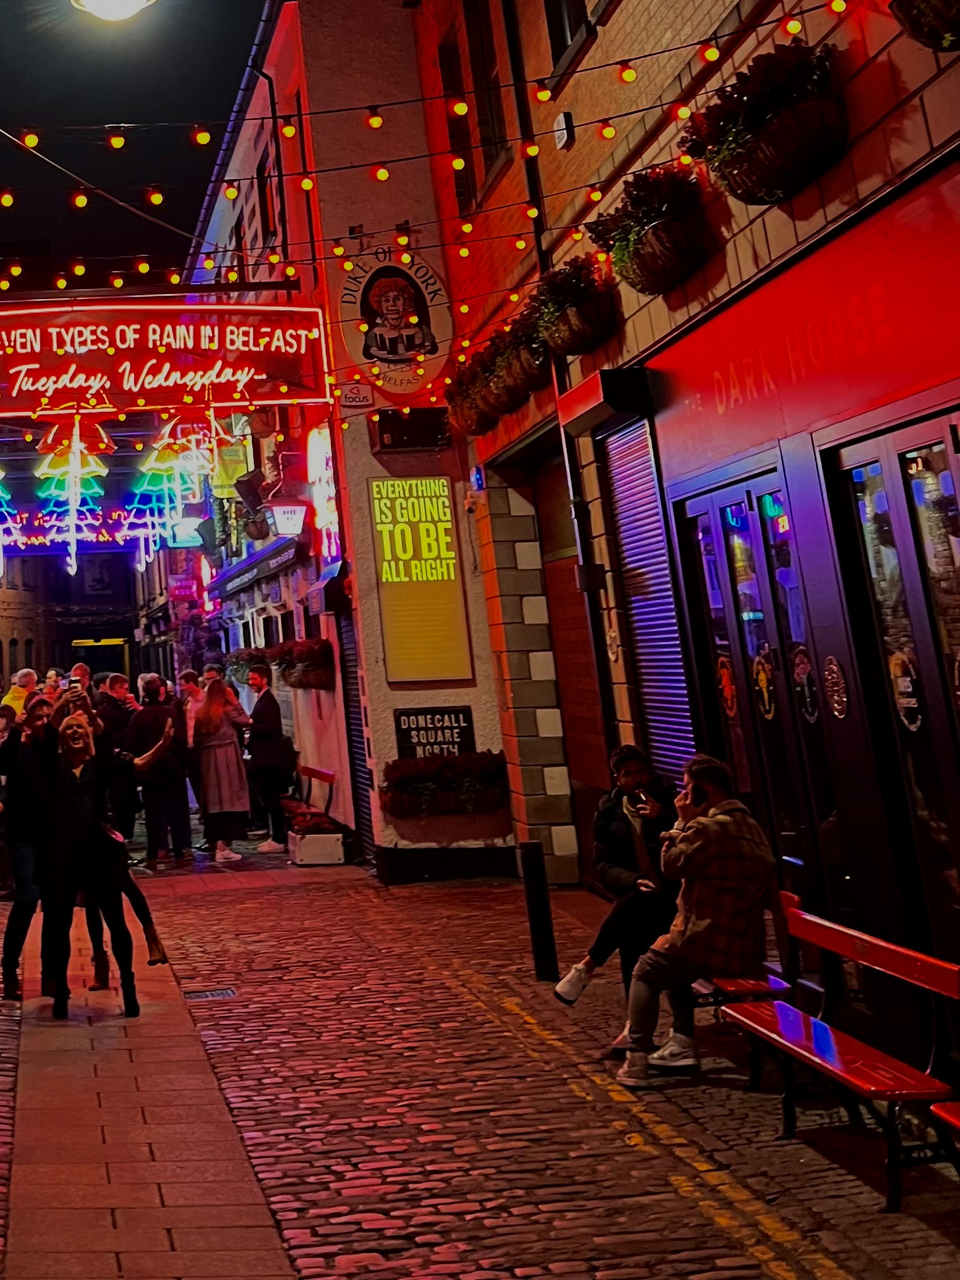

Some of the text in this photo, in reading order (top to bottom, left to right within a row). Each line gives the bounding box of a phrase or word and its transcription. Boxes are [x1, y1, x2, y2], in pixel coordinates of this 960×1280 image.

[341, 260, 373, 305] DUKE
[408, 255, 445, 303] YORK
[47, 325, 110, 354] TYPES
[115, 324, 141, 349] OF
[148, 324, 194, 349] RAIN
[200, 325, 219, 350] IN
[382, 373, 424, 388] BELFAS
[344, 393, 369, 403] focus
[372, 478, 449, 499] EVERYTHING
[373, 497, 452, 523] IS GOING
[376, 522, 456, 561] TO BE
[382, 559, 457, 583] ALL RIGHT
[410, 729, 462, 743] SQUARE
